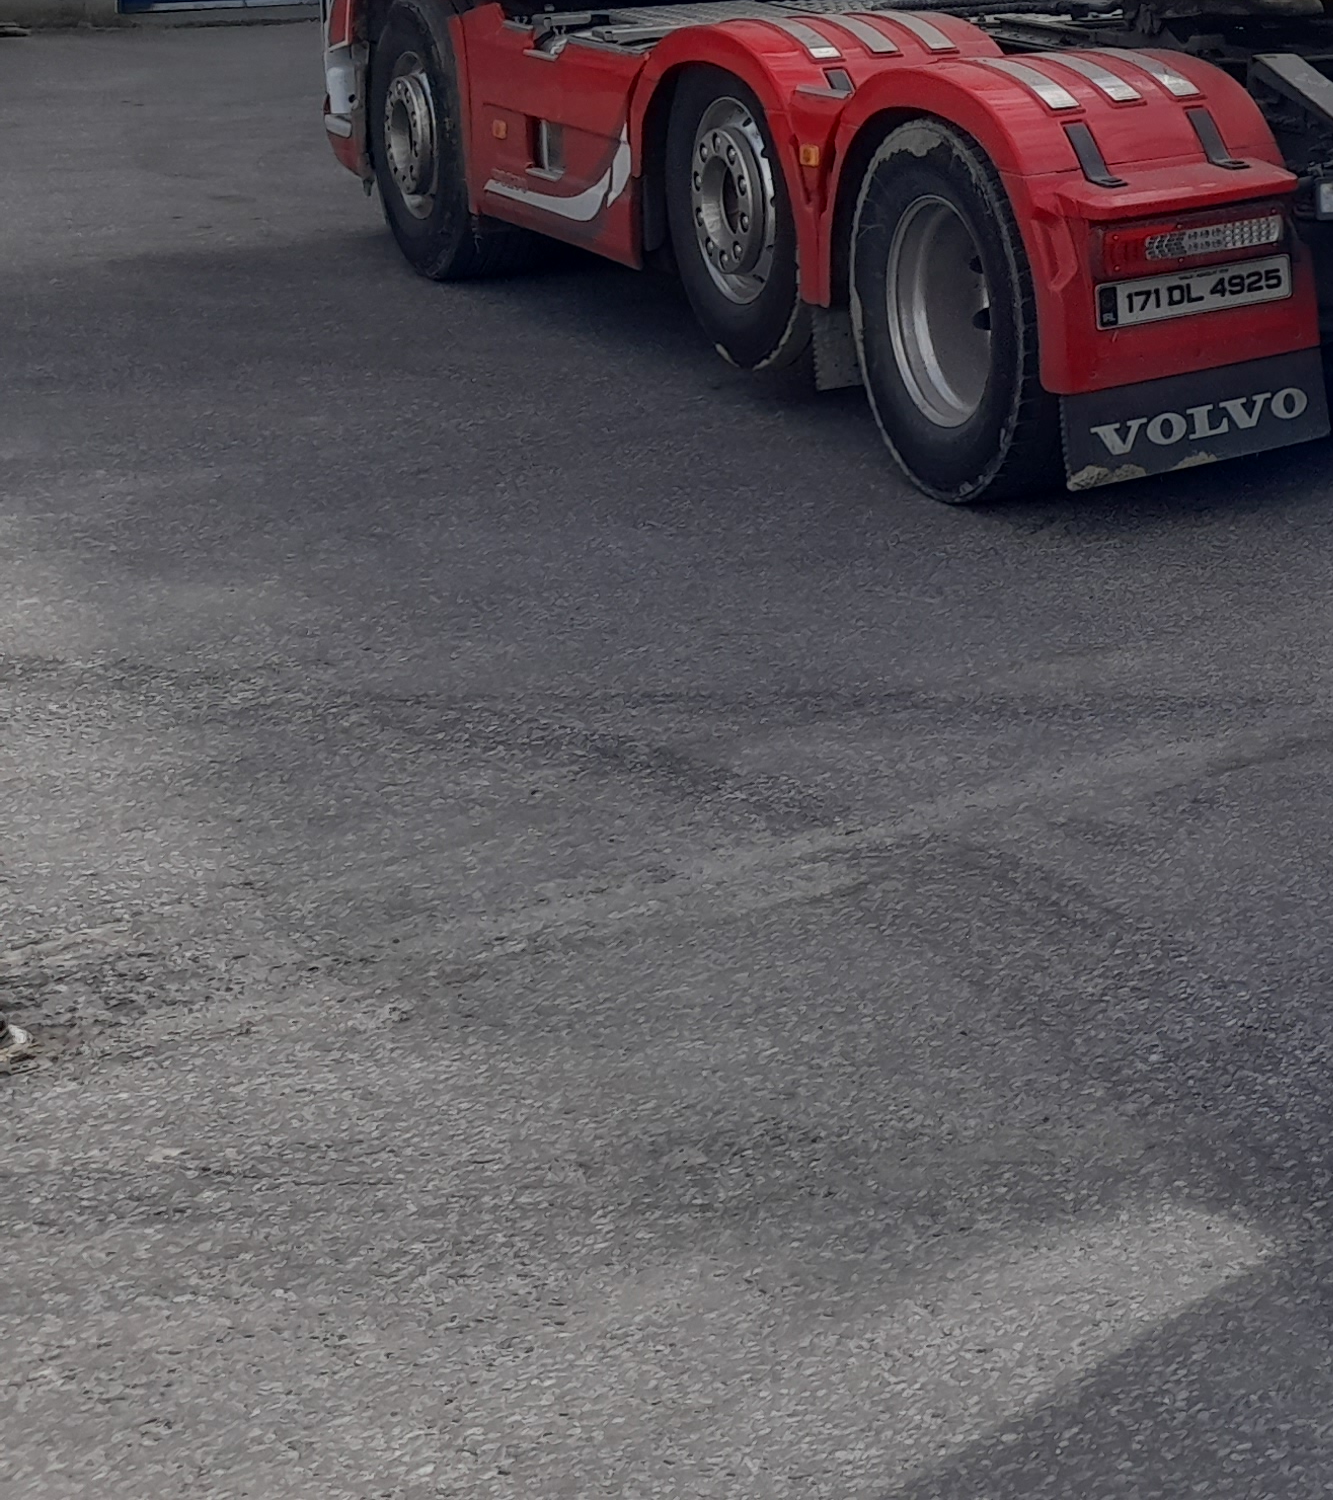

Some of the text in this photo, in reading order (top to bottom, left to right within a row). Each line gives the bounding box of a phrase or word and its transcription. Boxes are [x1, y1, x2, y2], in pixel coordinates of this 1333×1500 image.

[1126, 287, 1161, 314] 171
[1166, 282, 1205, 307] DL
[1209, 267, 1283, 298] 4925
[1089, 387, 1308, 456] VOLVO
